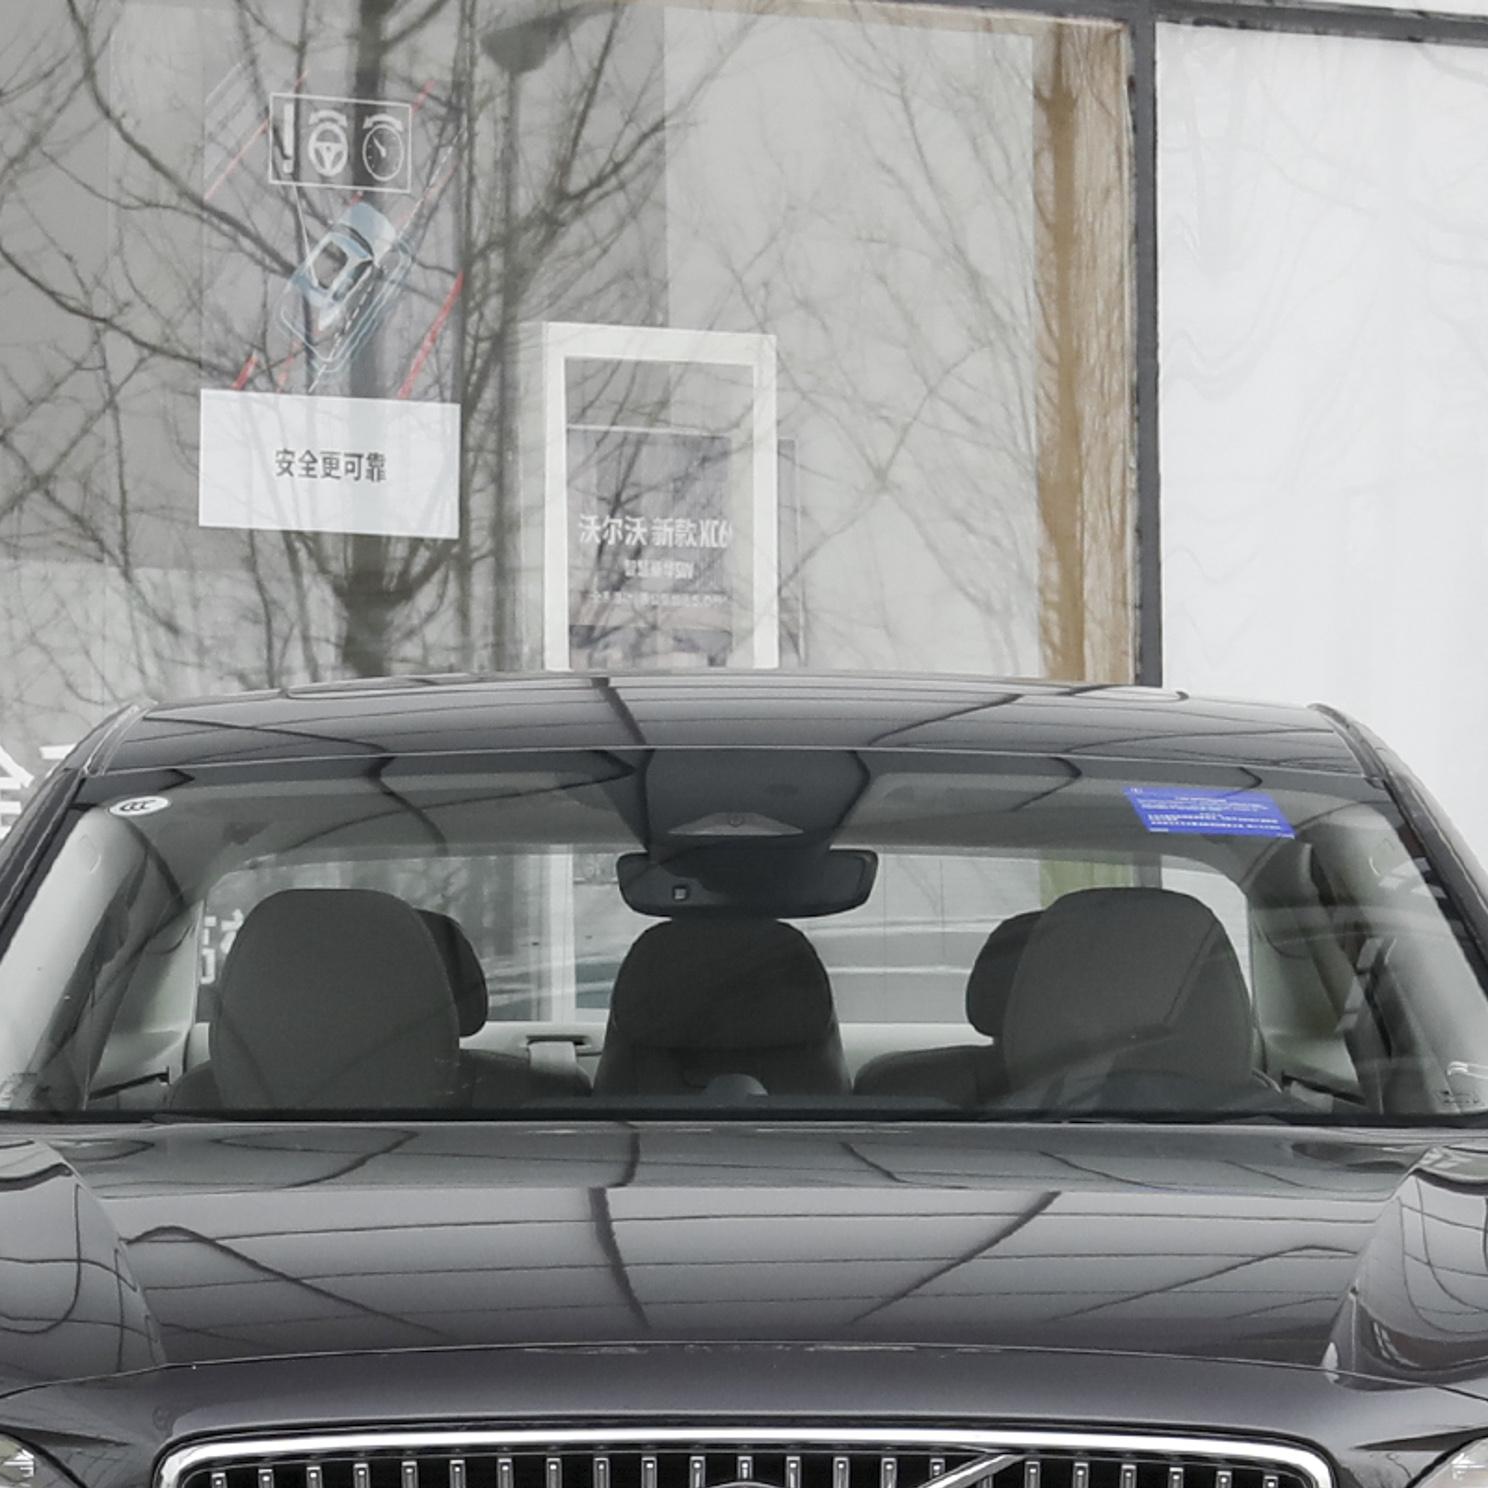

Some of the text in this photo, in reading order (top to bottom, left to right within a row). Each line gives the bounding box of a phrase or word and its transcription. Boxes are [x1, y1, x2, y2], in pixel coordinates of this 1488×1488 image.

[275, 448, 386, 483] 安全更可靠
[578, 514, 648, 546] 沃尔沃
